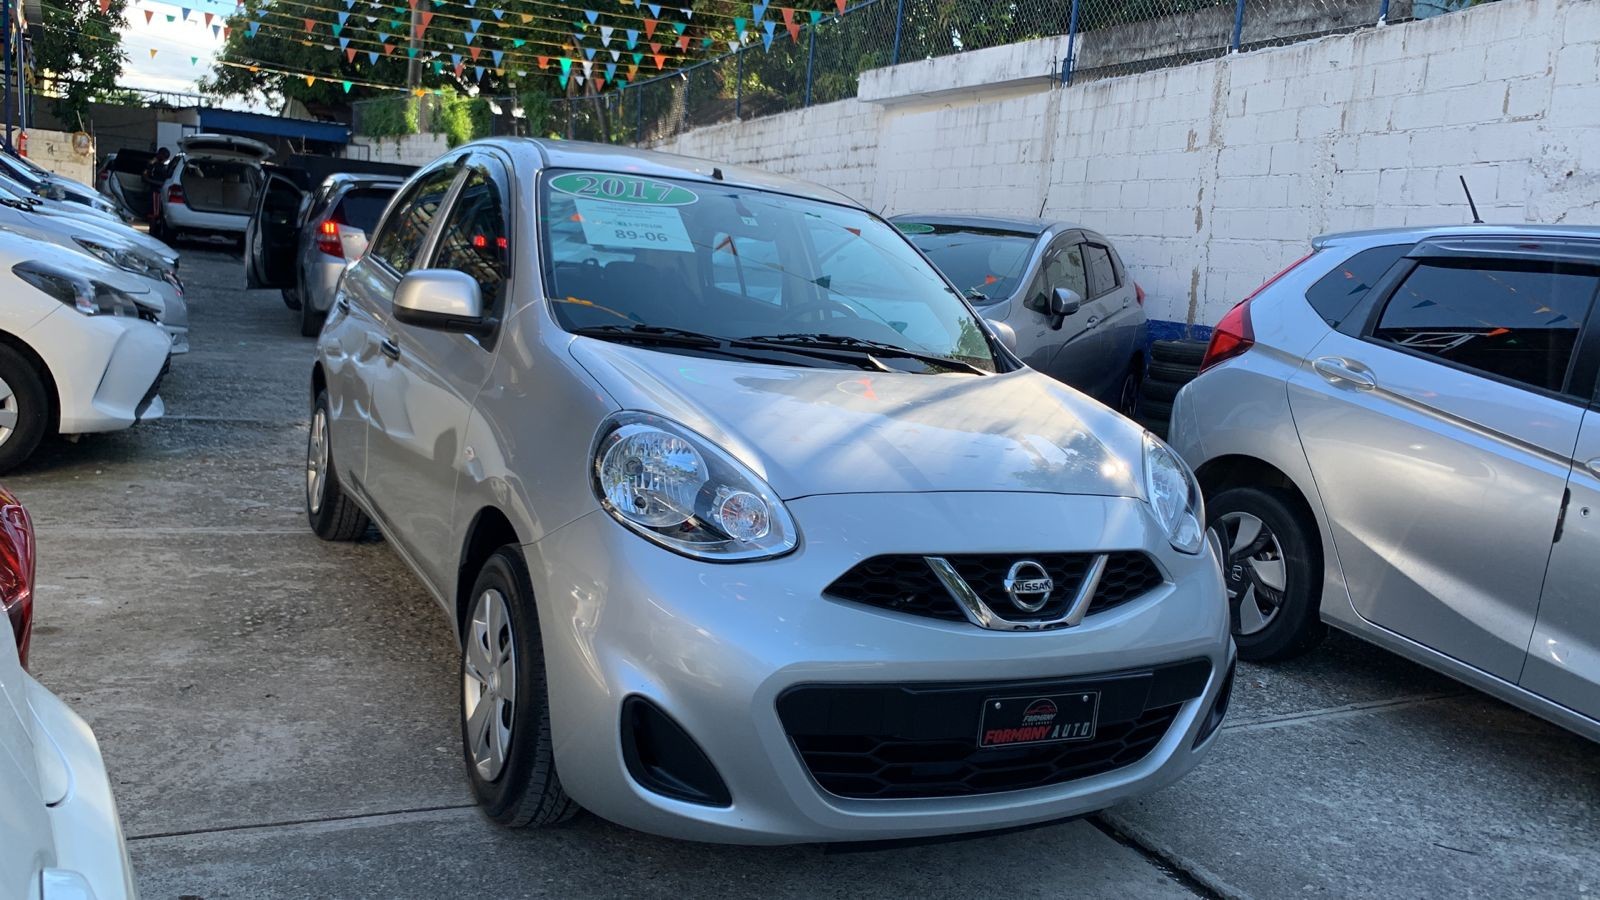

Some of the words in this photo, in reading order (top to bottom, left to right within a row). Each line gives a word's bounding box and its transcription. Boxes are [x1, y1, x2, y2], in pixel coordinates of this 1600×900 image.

[576, 175, 674, 202] 2017
[615, 229, 669, 242] 89-06
[984, 726, 1052, 744] FORMANY
[1051, 722, 1091, 739] AUTO
